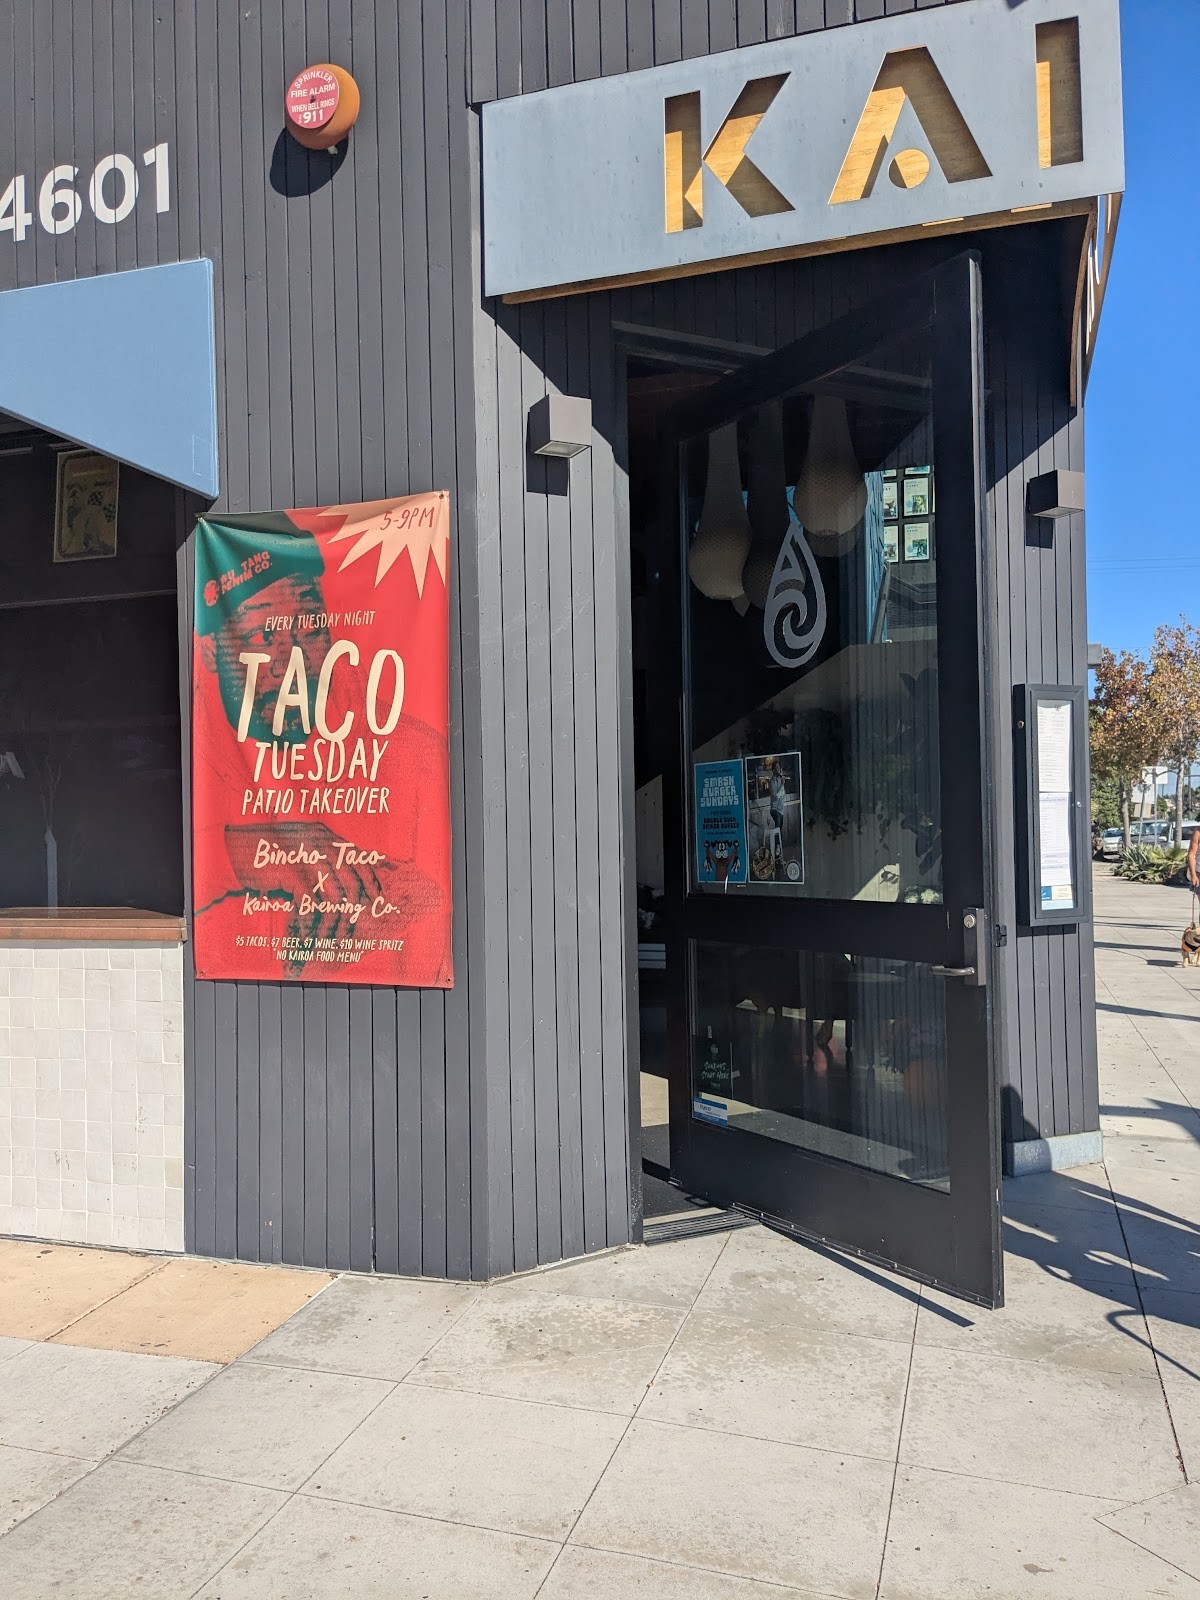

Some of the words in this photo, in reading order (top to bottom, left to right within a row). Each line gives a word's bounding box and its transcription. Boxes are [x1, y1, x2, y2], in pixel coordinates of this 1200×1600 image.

[294, 70, 333, 89] SPRINKLER
[291, 89, 308, 98] FIRE
[309, 83, 336, 96] ALARM
[291, 104, 308, 113] WHEN
[308, 102, 319, 111] BELL
[320, 98, 335, 108] RINGS
[302, 109, 324, 124] 911
[0, 142, 170, 242] 4601
[379, 507, 435, 531] 5-9PM
[240, 551, 270, 572] TANG
[265, 615, 294, 632] EVERY
[297, 612, 341, 630] TUESDAY
[343, 610, 376, 627] NIGHT
[237, 639, 405, 743] TACO
[253, 737, 389, 783] TUESDAY
[702, 785, 737, 798] BURGER
[704, 775, 735, 787] SMASH
[241, 787, 294, 816] PATIO
[299, 786, 390, 815] TAKEOVER
[253, 838, 327, 869] Bincho
[332, 841, 386, 870] Taco
[242, 893, 294, 916] Kairoa
[299, 894, 366, 924] Brewing
[371, 896, 401, 918] Co.
[235, 935, 245, 947] $5
[271, 936, 280, 948] $7
[303, 937, 314, 949] $7
[340, 937, 353, 950] $10
[354, 939, 377, 951] WINE
[378, 939, 404, 951] SPRITZ
[288, 949, 314, 961] KAIROA
[316, 951, 335, 962] FOOD
